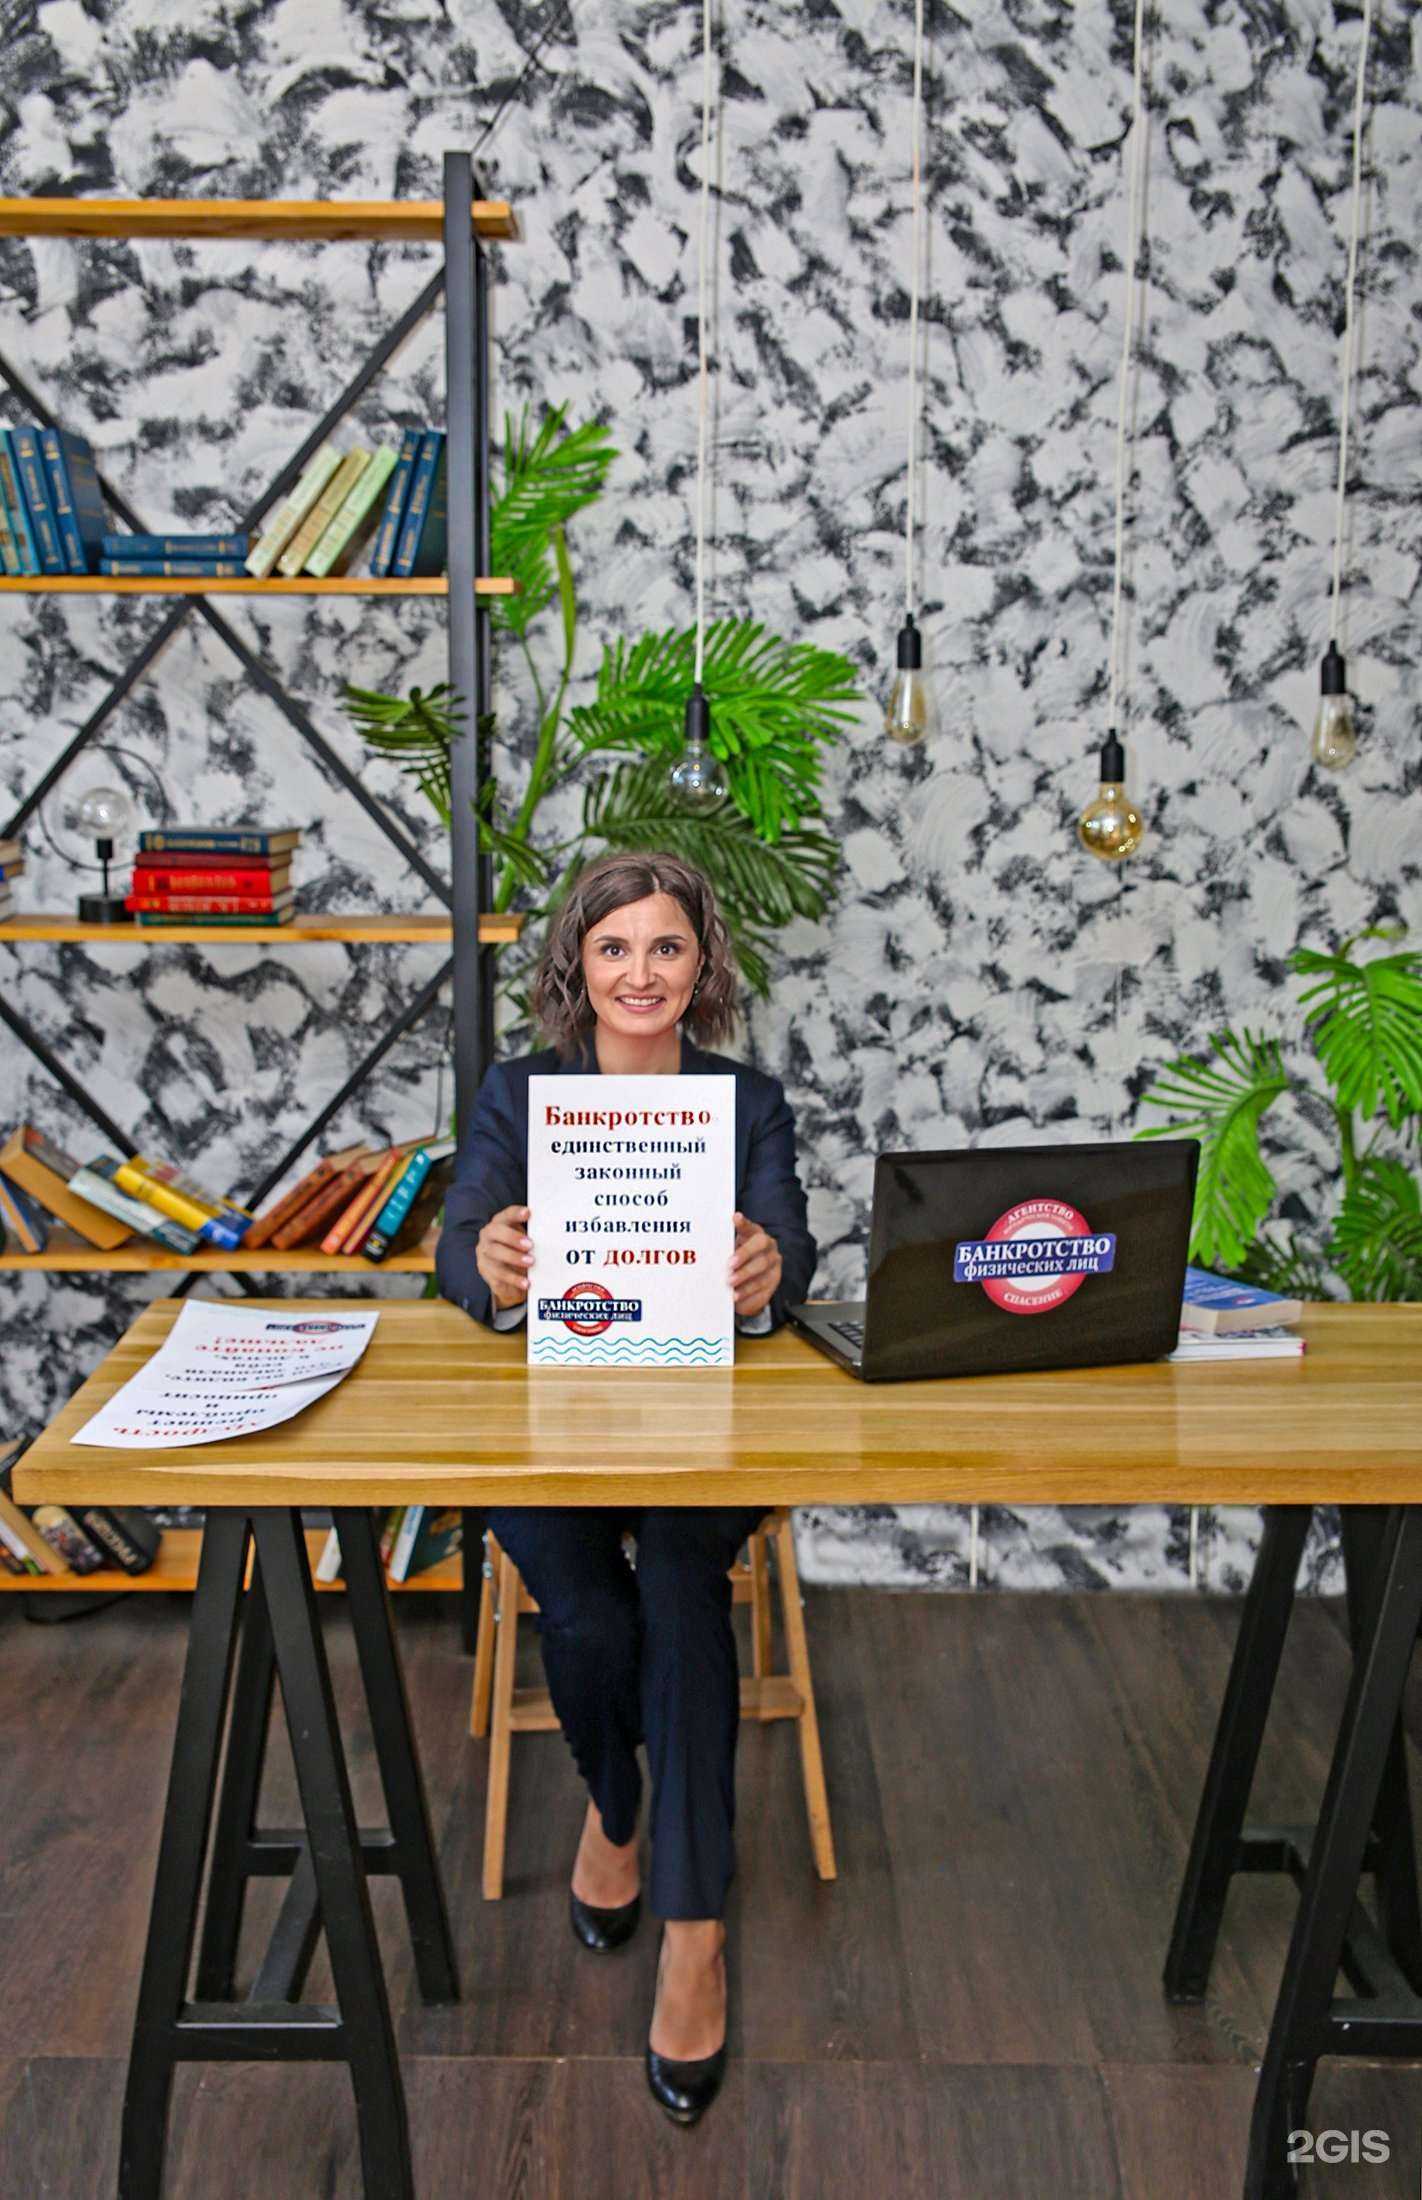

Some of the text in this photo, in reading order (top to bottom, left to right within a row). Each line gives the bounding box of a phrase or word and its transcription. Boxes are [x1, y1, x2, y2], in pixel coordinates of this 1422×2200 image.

[545, 1105, 712, 1130] Банкротство
[551, 1137, 706, 1155] единственный
[574, 1163, 682, 1180] законный
[594, 1189, 669, 1207] способ
[1007, 1203, 1074, 1223] АГЕНТСТВО
[565, 1216, 691, 1233] избавления
[565, 1249, 697, 1268] от долгов
[958, 1237, 1111, 1263] БАНКРОТСТВО
[964, 1256, 1099, 1281] физических лиц
[540, 1300, 639, 1312] БАНКРОТСТВО
